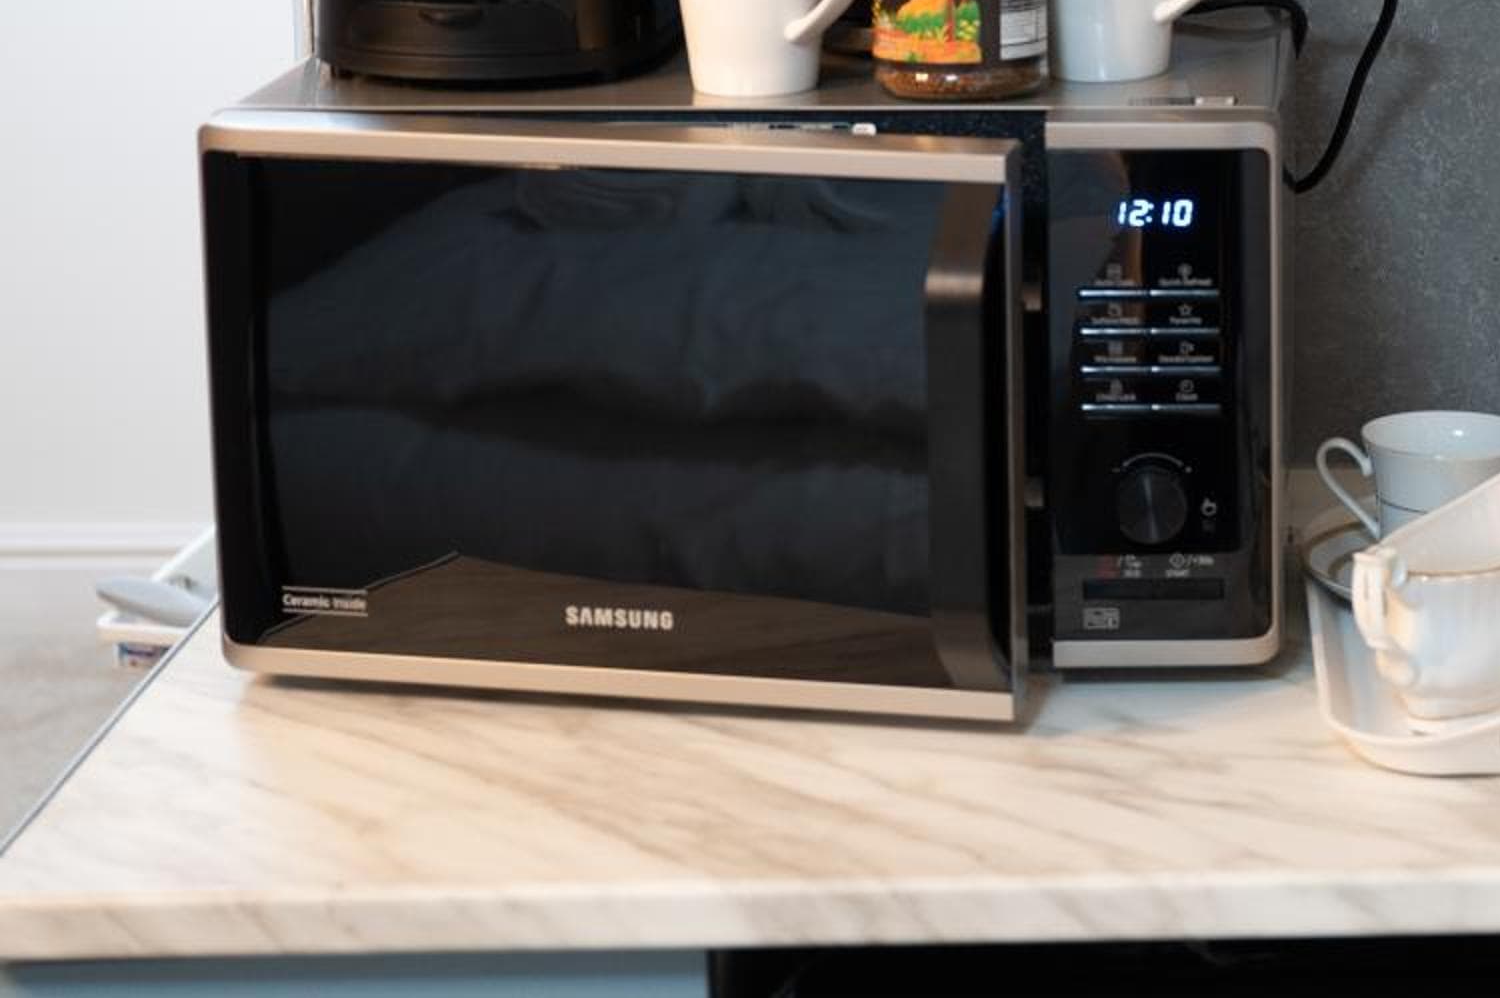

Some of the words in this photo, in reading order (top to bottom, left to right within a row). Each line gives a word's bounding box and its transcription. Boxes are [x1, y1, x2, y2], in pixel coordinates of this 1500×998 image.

[1118, 199, 1194, 227] 12:10
[282, 593, 330, 607] Ceramic
[564, 605, 674, 630] SAMSUNG
